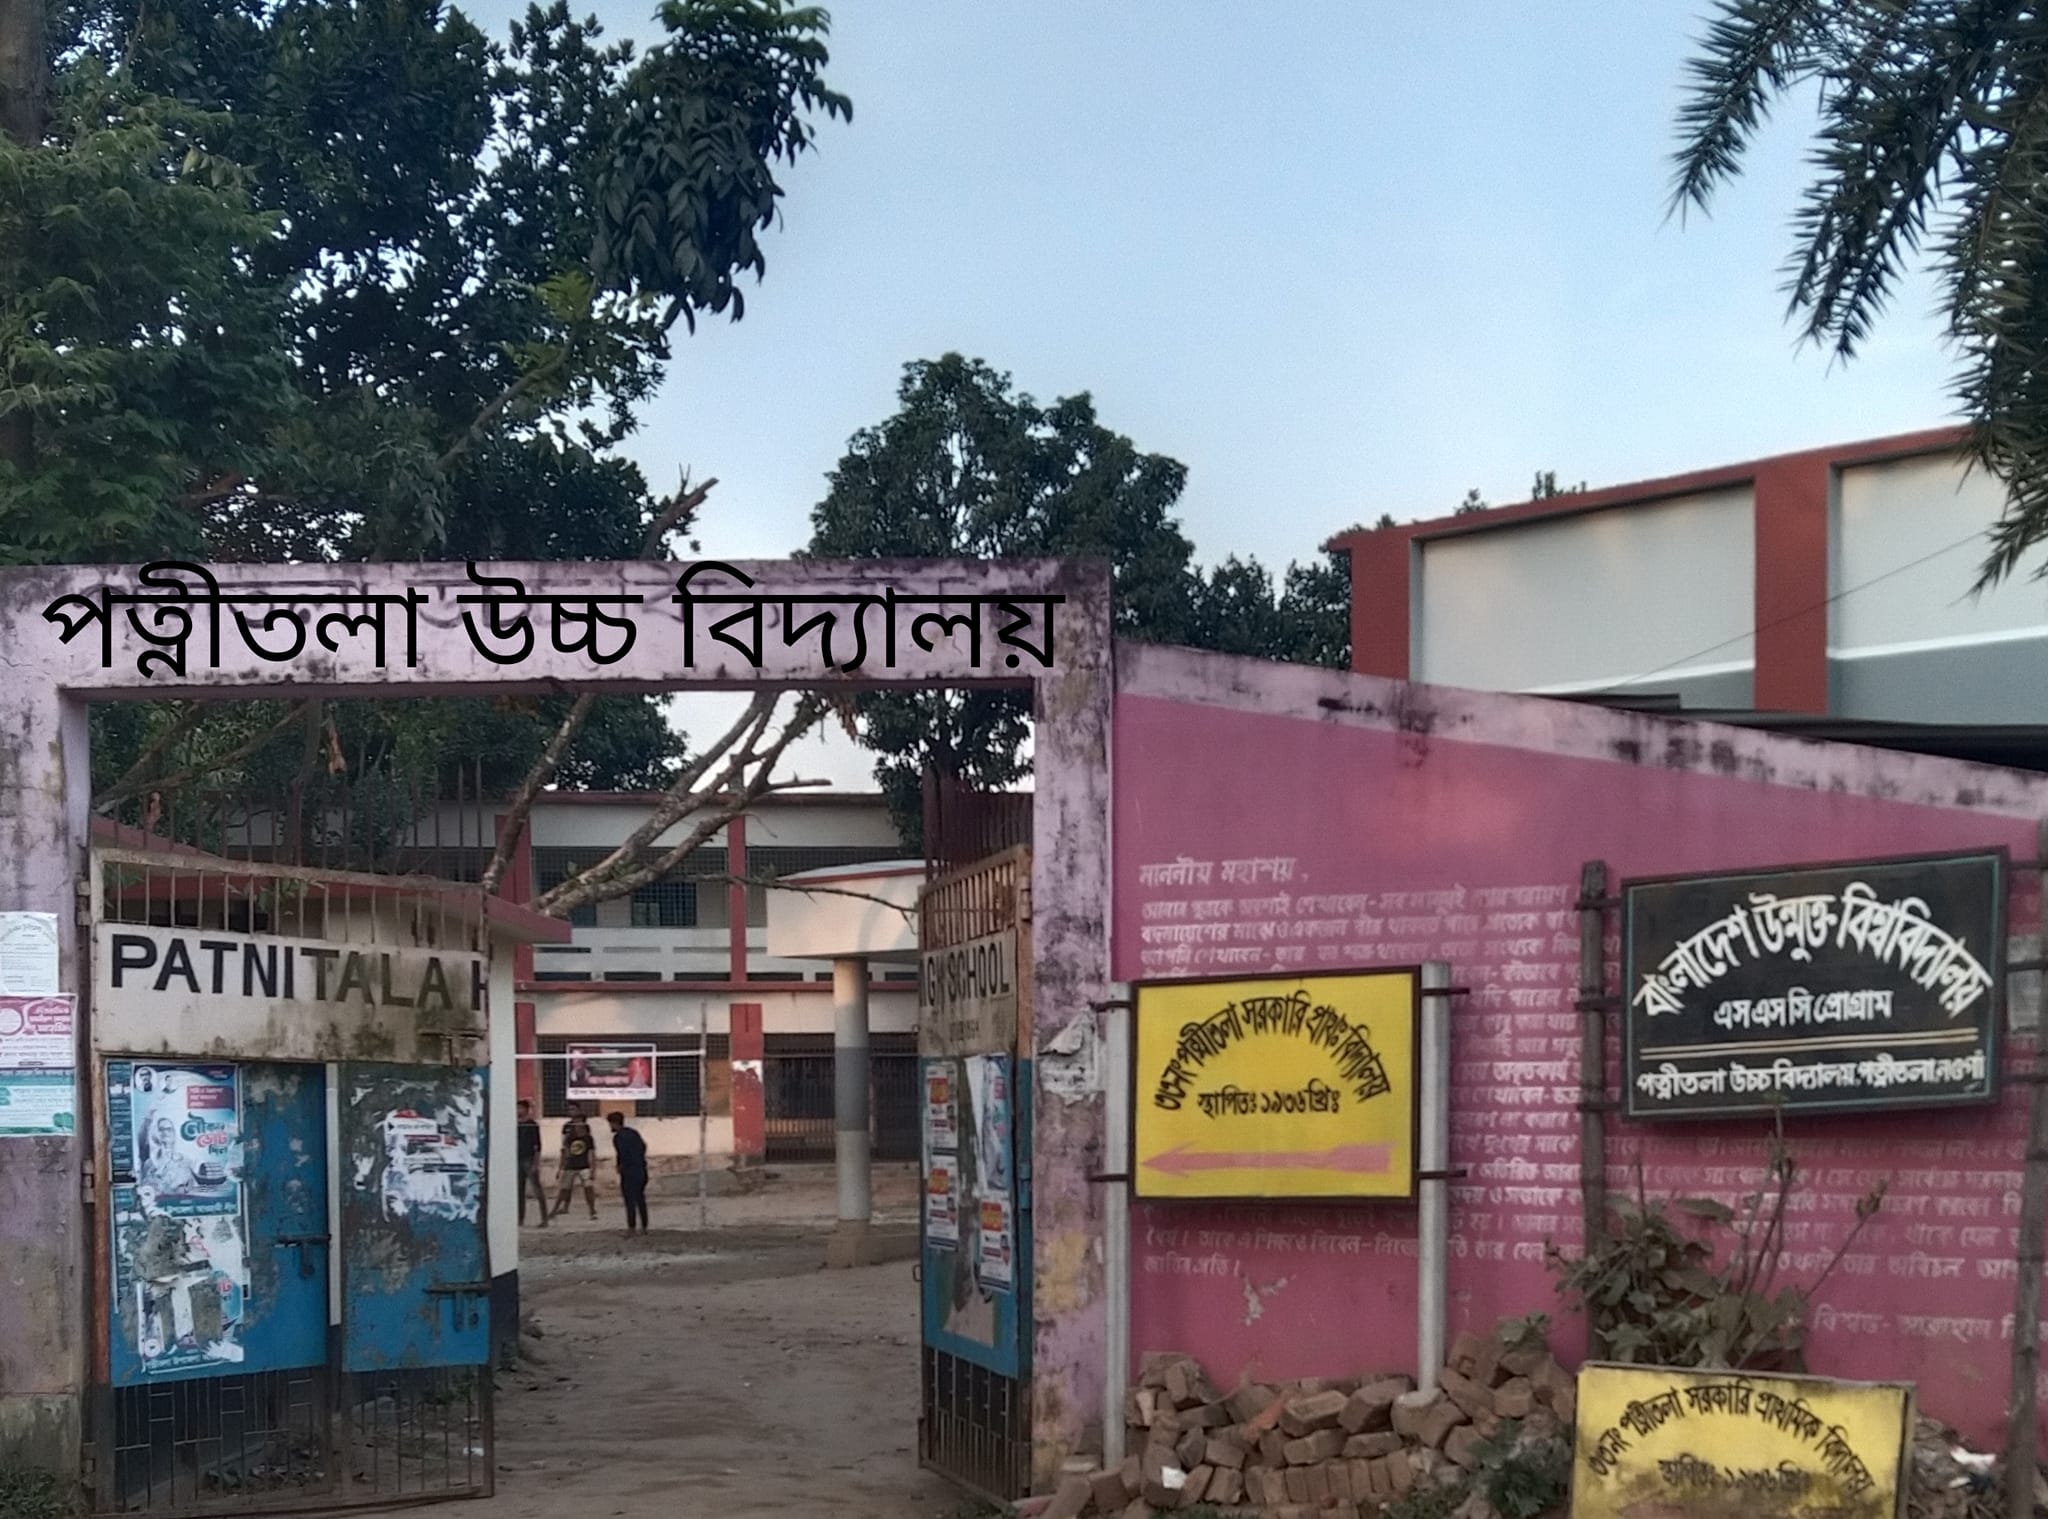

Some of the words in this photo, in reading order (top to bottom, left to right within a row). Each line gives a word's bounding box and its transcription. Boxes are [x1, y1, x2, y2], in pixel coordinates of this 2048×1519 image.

[1139, 854, 1215, 888] মাননীয়
[110, 933, 454, 1011] PATNITALA
[947, 940, 1010, 1003] SCHOOL
[1631, 903, 1761, 1016] বাংলাদেশ
[1748, 892, 1839, 963] উন্মুক্ত
[1836, 881, 1994, 1019] বিশ্ববিদ্যালয়
[1813, 989, 1895, 1024] প্রোগ্রাম
[1240, 989, 1312, 1038] সরকারি
[1329, 1023, 1391, 1105] বিদ্যালয়
[1636, 1062, 1728, 1100] পত্নীতলা
[1729, 1060, 1772, 1093] উচ্চ
[1683, 1378, 1755, 1417] সরকারি
[1754, 1391, 1824, 1444] প্রাথমিক
